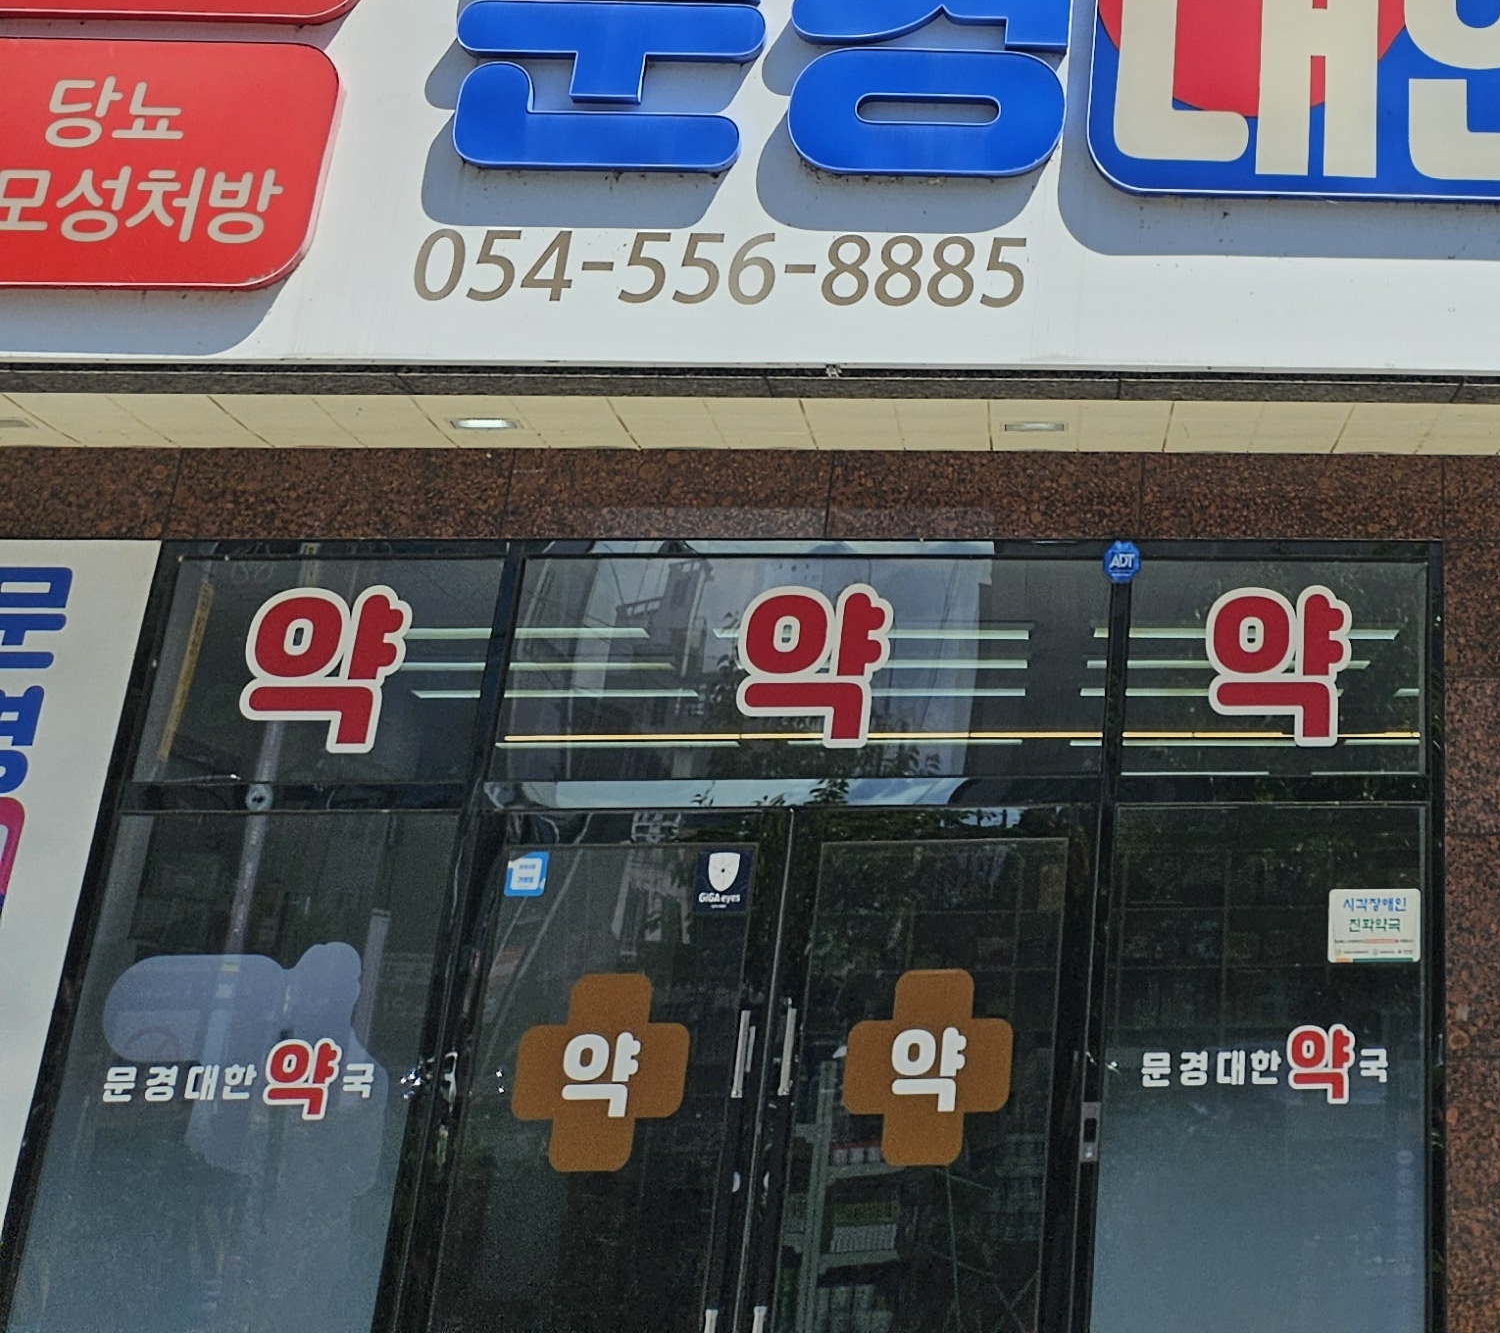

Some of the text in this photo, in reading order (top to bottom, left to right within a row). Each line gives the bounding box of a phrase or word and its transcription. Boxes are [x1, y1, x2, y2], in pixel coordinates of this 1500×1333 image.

[44, 75, 184, 149] 당뇨
[412, 227, 1028, 308] 054-556-8885
[1109, 553, 1135, 569] ADT
[239, 584, 412, 753] 약
[736, 582, 894, 749] 약
[1205, 584, 1353, 747] 약
[1343, 897, 1406, 912] 시각장애인
[561, 1031, 642, 1118] 약
[890, 1026, 968, 1113] 약
